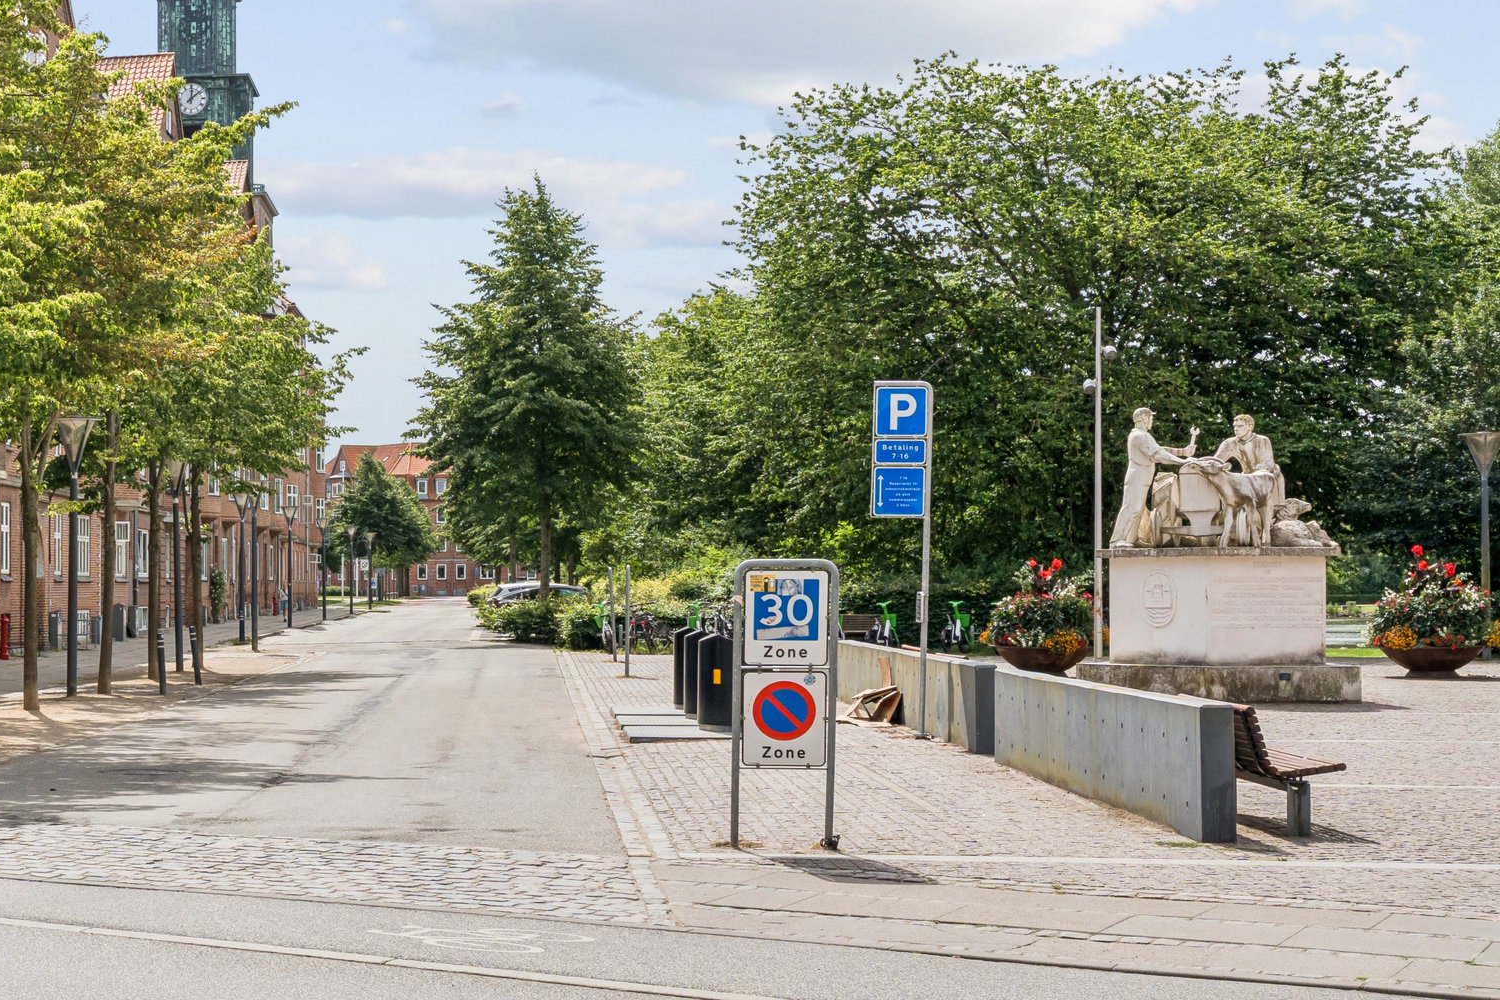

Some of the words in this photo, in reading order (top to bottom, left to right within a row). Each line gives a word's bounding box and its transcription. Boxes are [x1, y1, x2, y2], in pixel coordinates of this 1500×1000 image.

[889, 393, 917, 431] P
[882, 444, 919, 452] Betaling
[760, 594, 814, 626] 30
[763, 645, 808, 658] Zone
[762, 745, 806, 759] Zone
